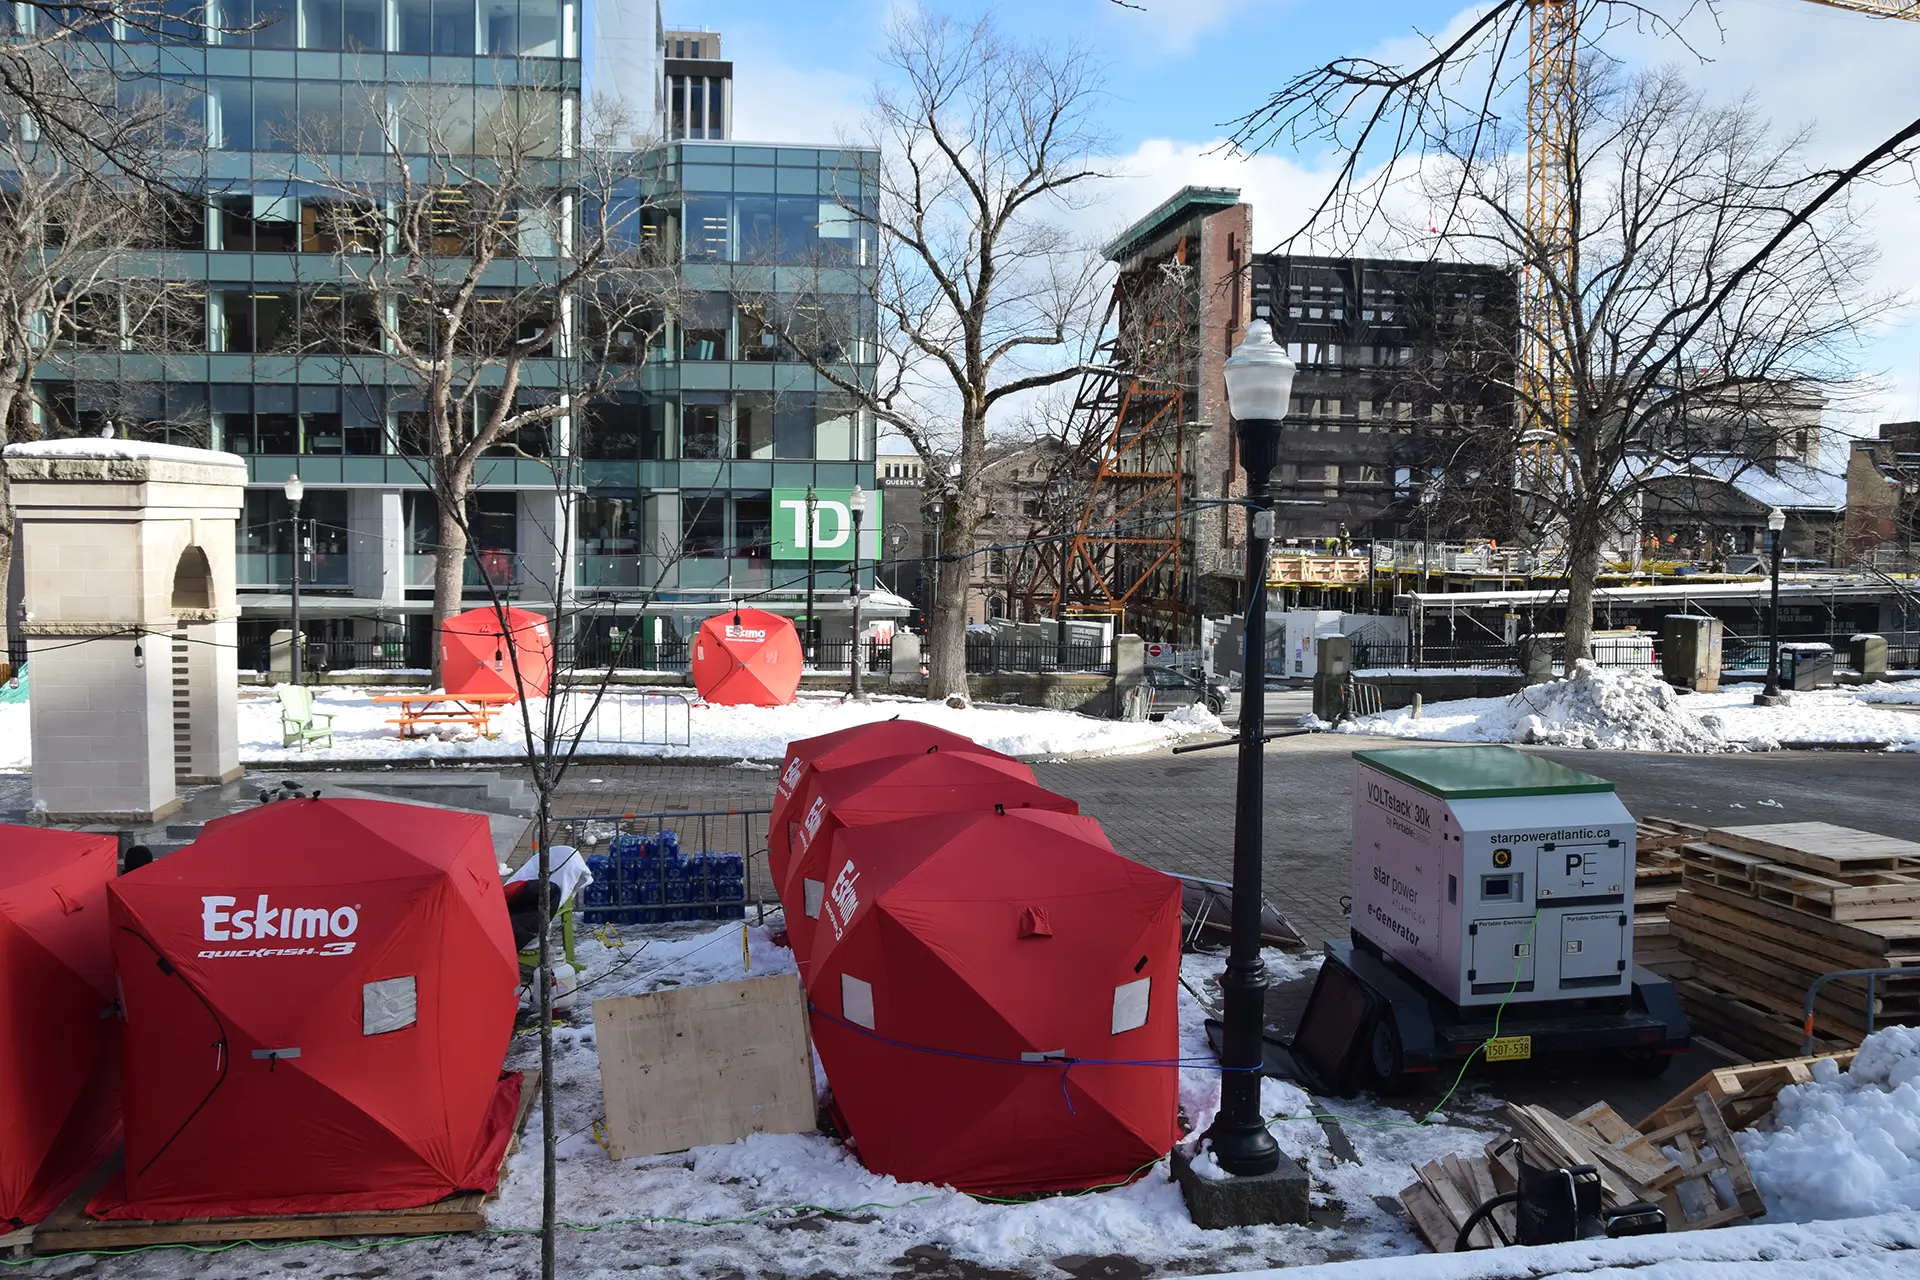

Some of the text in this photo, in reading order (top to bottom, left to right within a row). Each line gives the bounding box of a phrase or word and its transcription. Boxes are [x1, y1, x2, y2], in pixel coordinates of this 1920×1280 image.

[780, 500, 850, 548] TD
[725, 625, 765, 638] Ekimo
[1367, 781, 1431, 828] VOLTstack 30k
[1490, 828, 1611, 845] starpoweratlantic.ca
[1565, 852, 1597, 876] PE
[1373, 866, 1418, 904] star power
[201, 894, 359, 941] Eskimo
[1367, 903, 1420, 946] e-Generator
[197, 941, 356, 958] QUICKFISH 3
[1487, 1043, 1530, 1056] T507-538
